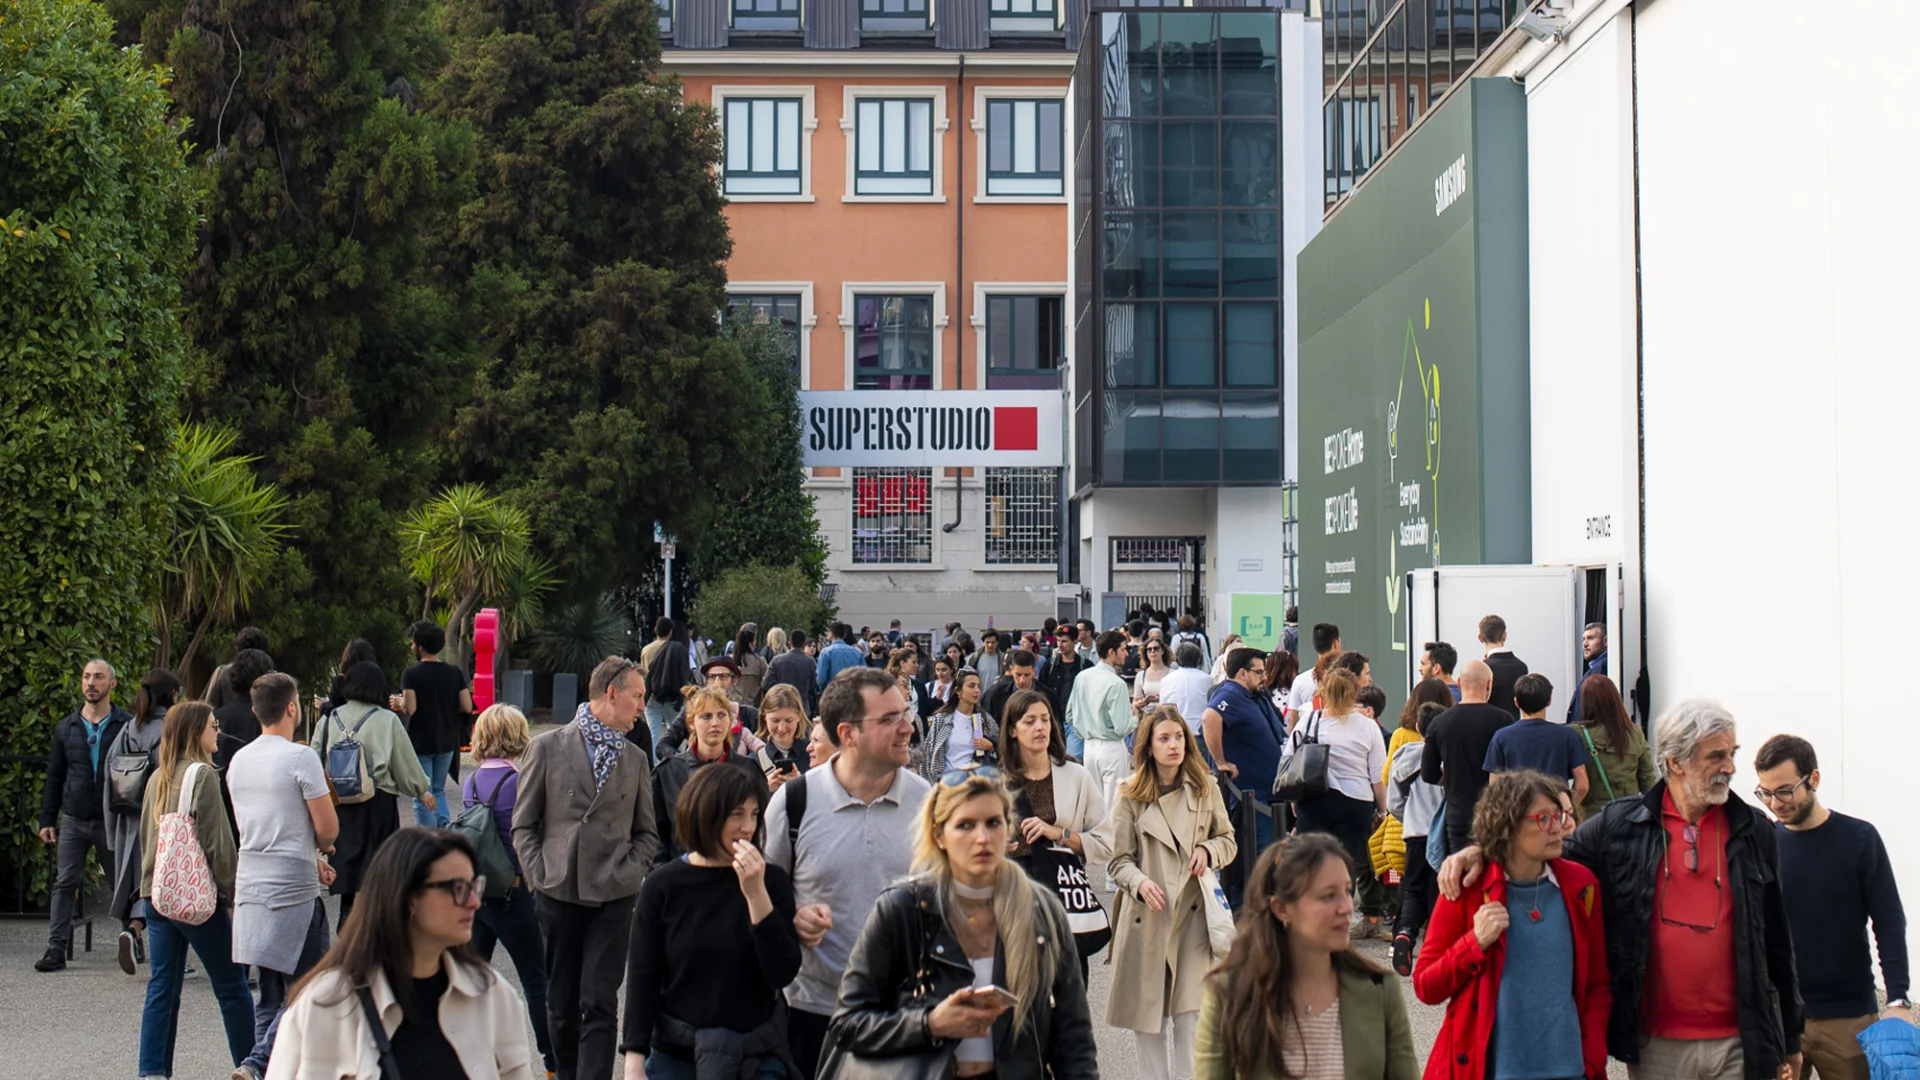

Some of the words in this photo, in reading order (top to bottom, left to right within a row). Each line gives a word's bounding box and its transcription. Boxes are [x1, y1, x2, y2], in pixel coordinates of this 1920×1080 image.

[1434, 152, 1466, 217] SAMSUNG
[809, 406, 991, 451] SUPERSTUDIO
[1324, 429, 1348, 475] BESPOKE
[1348, 426, 1364, 467] Home
[1325, 492, 1348, 536] BESPOKE
[1348, 486, 1358, 532] Life
[1399, 479, 1420, 513] Everyday
[1399, 516, 1430, 554] Sustainability
[1586, 514, 1611, 540] ENTRANCE
